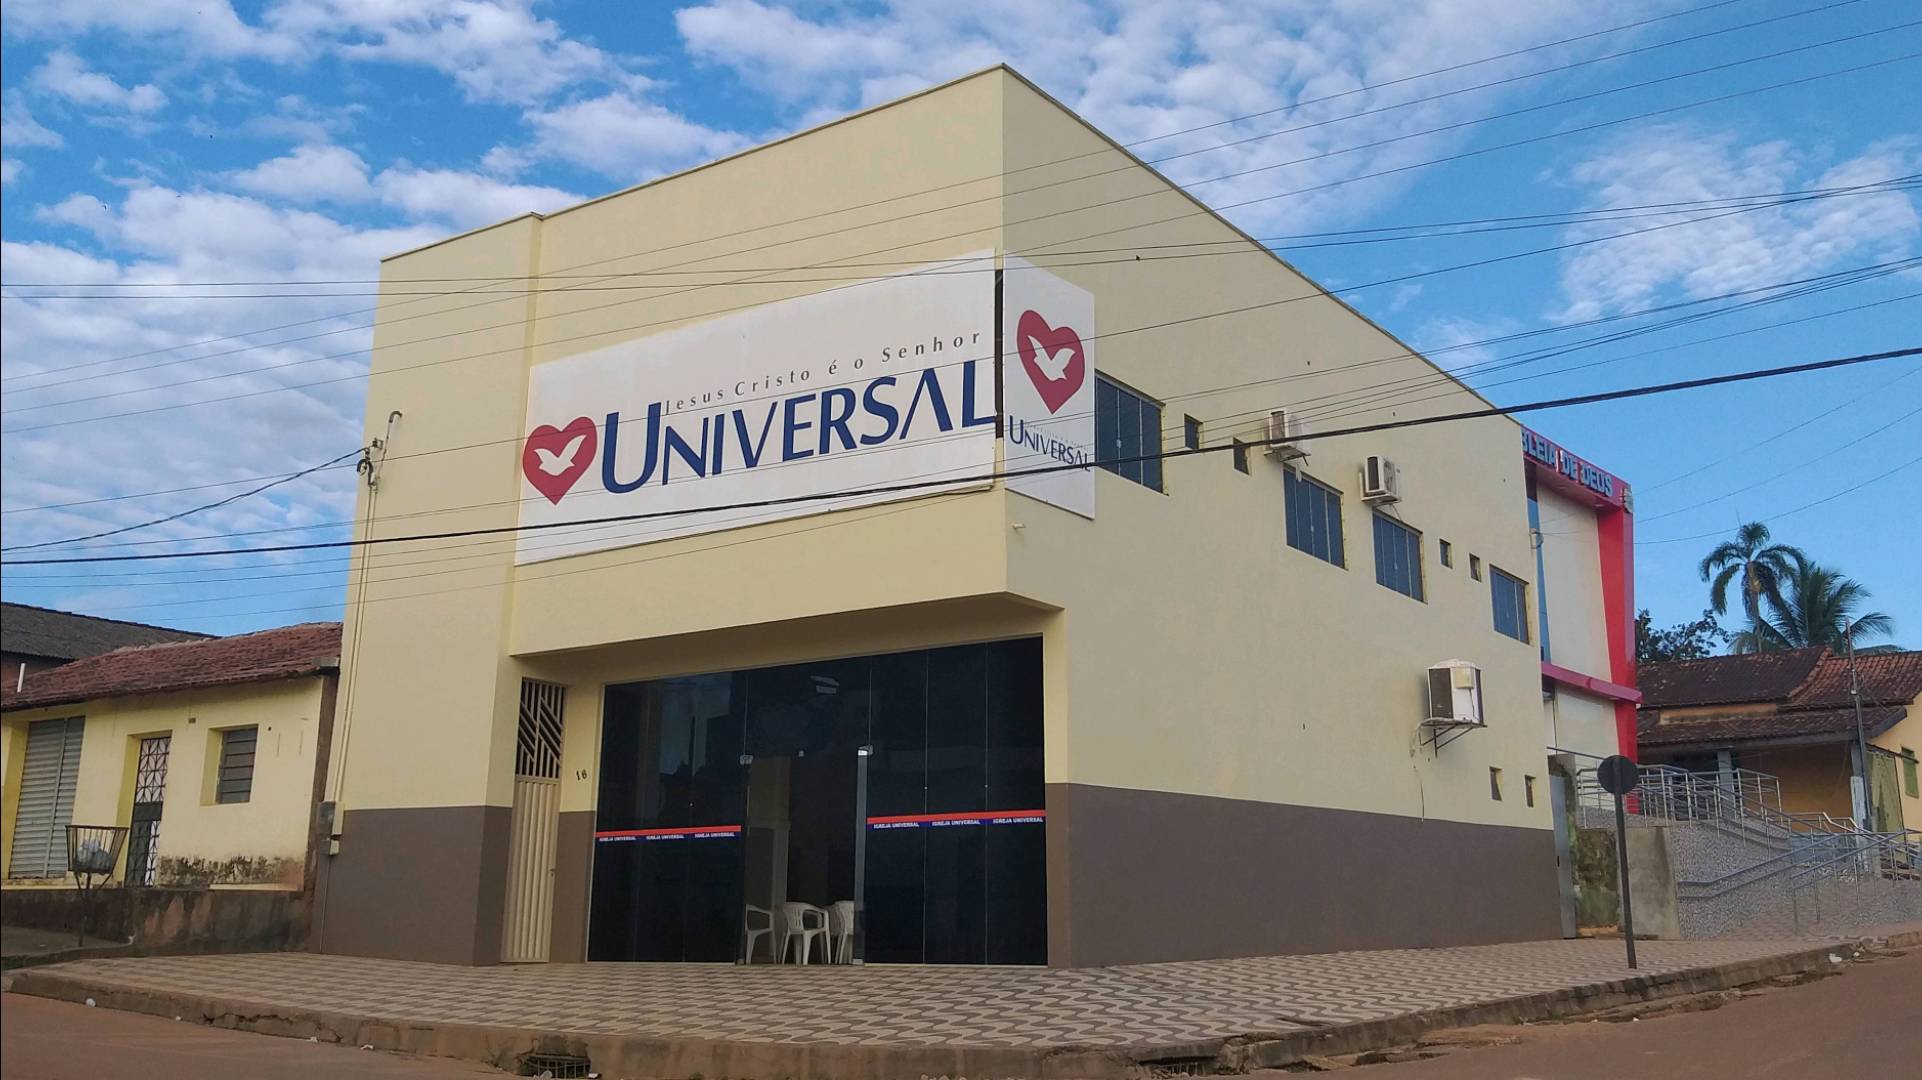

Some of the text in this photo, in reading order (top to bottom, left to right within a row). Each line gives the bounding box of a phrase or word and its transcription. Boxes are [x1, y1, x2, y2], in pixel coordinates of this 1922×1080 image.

[665, 331, 980, 415] Jesus Cristo é o Senhor
[601, 360, 997, 494] UNIVERSAL
[1009, 414, 1091, 473] UNIVERSAL
[1560, 449, 1578, 482] DE
[1580, 461, 1613, 497] DEUS
[575, 769, 588, 781] 16
